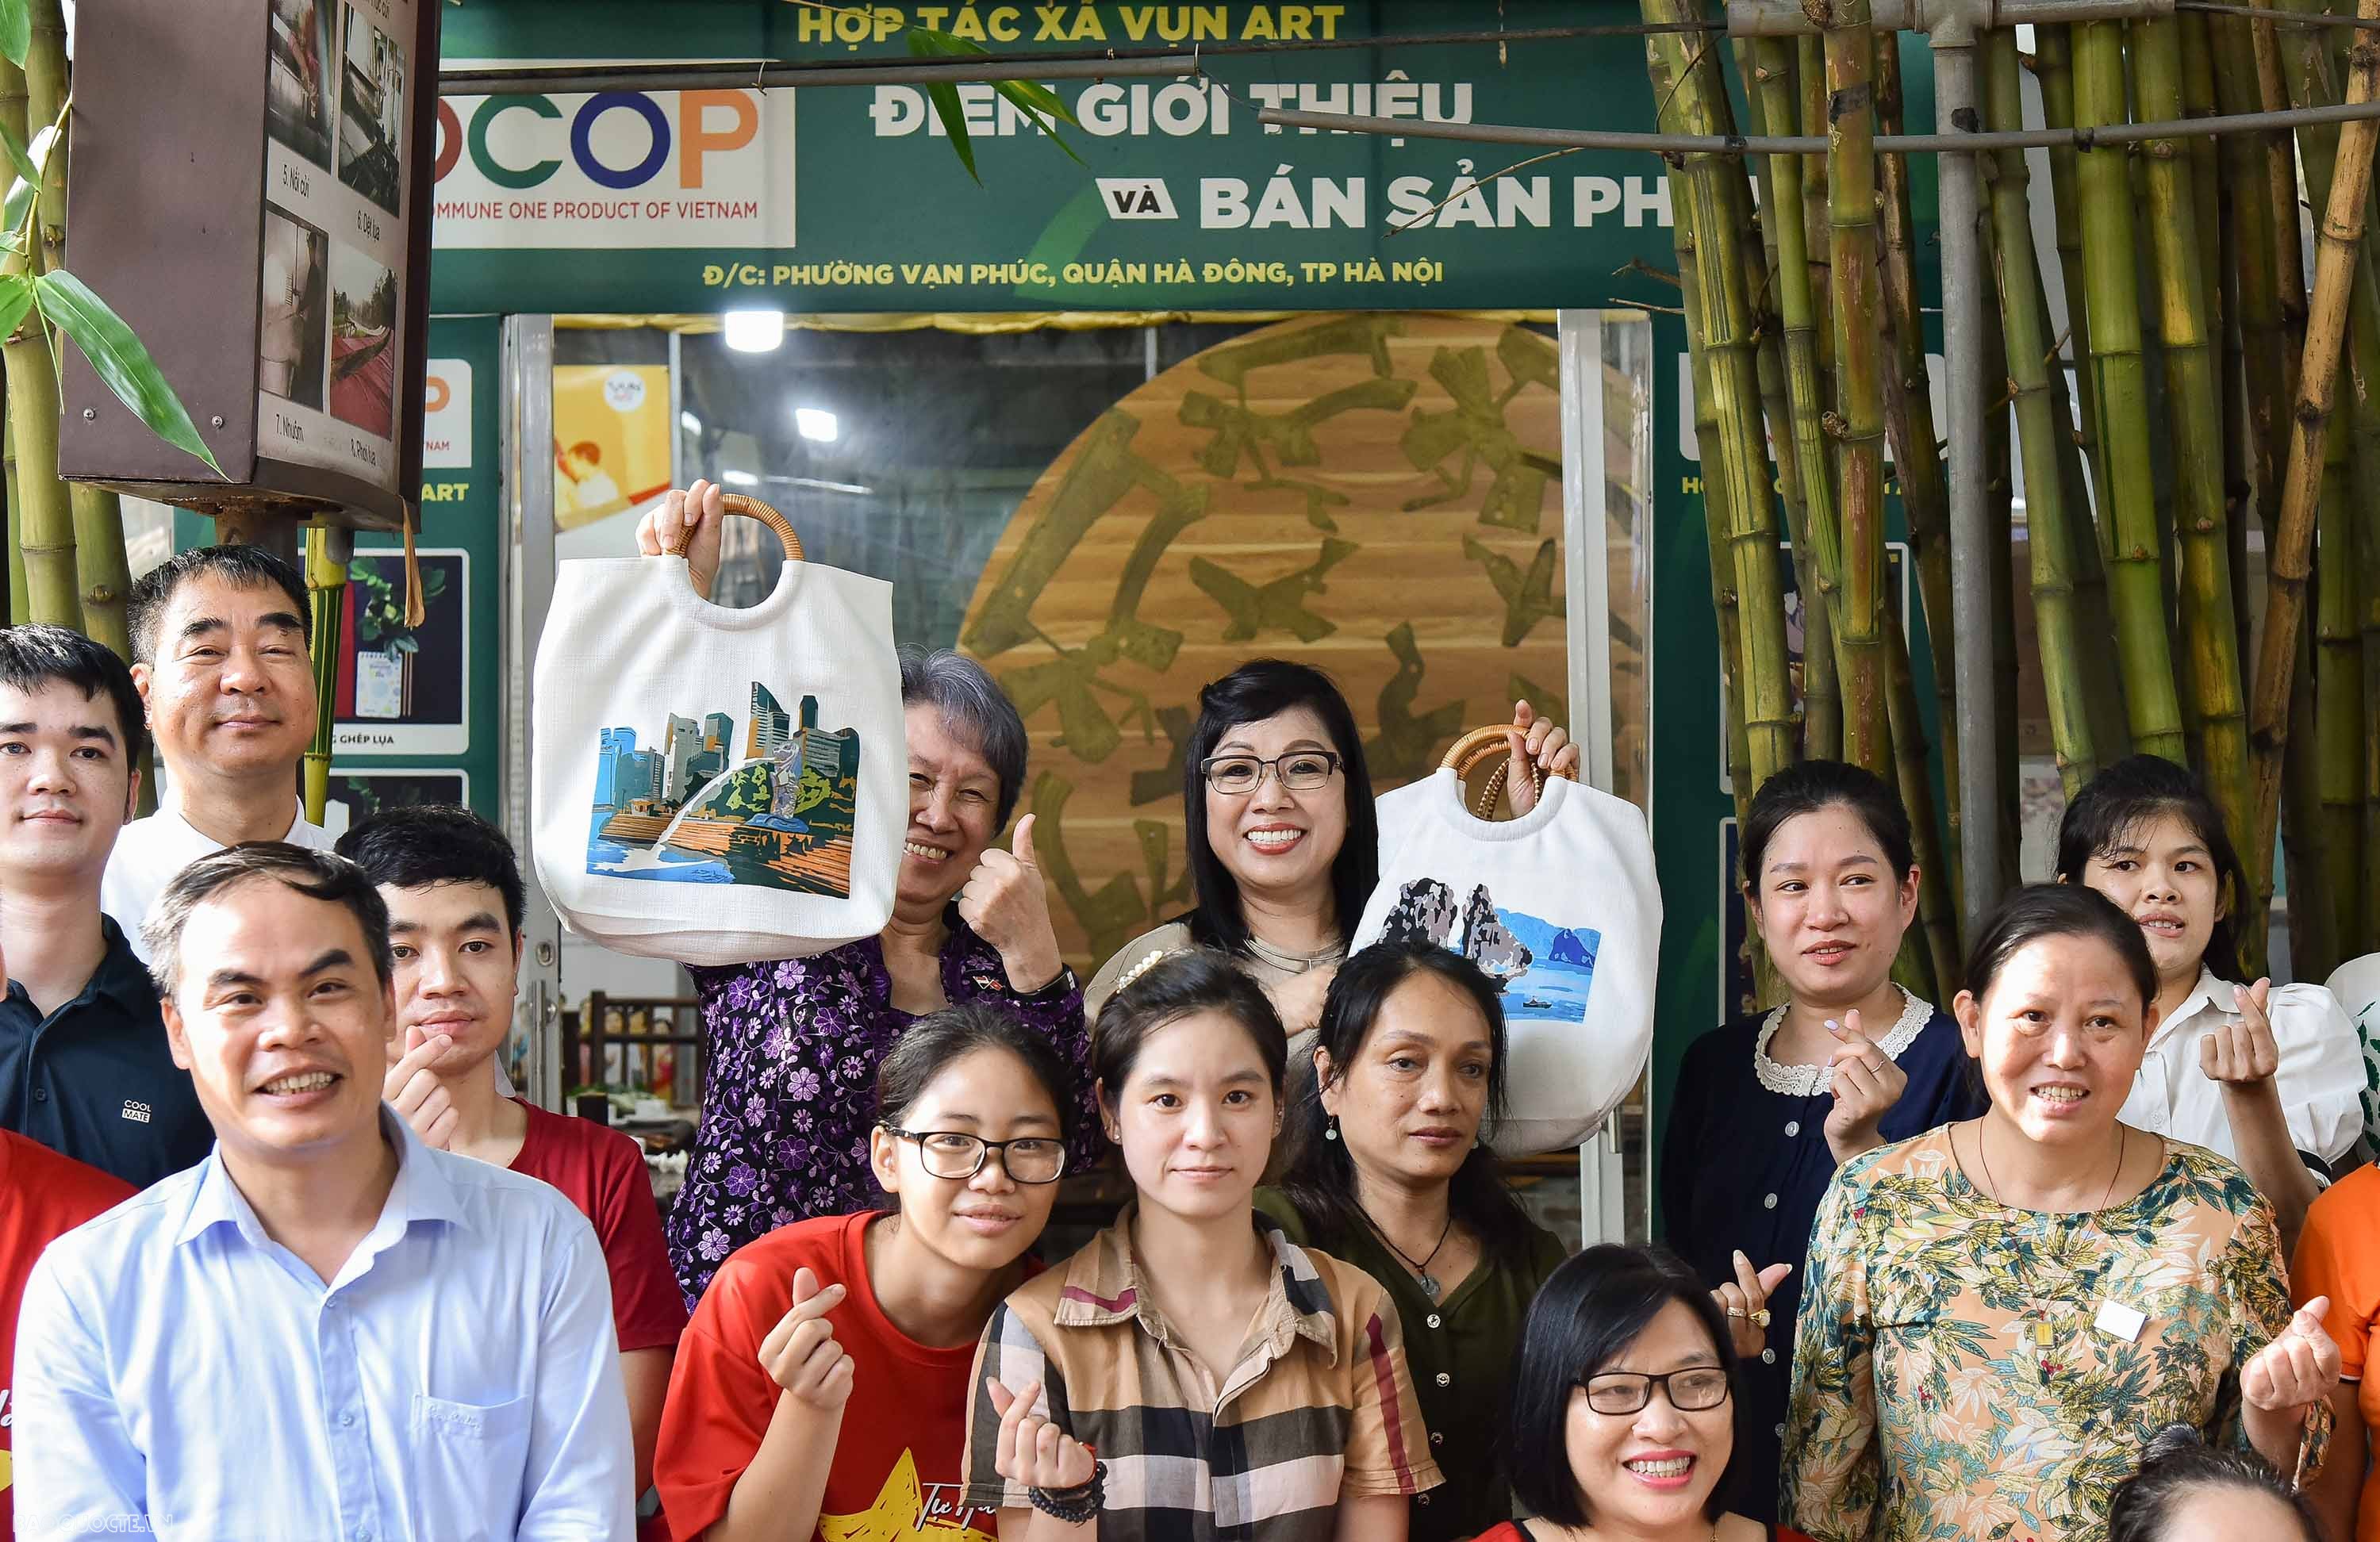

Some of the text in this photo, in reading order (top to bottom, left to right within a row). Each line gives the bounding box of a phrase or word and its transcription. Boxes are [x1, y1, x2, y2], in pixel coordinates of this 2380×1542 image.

[798, 0, 1345, 51] HỢP TÁC XÃ VỤN ART
[1077, 76, 1230, 136] GIỚI
[1250, 70, 1472, 147] THIỆU
[434, 90, 758, 189] COP
[1112, 184, 1161, 213] VÀ
[1200, 163, 1365, 228] BÁN
[1385, 159, 1550, 228] SẢN
[435, 201, 758, 219] MMUNE ONE PRODUCT OF VIETNAM
[703, 257, 1442, 289] Đ/C: PHƯỜNG VẠN PHÚC, QUẬN HÀ ĐÔNG, TP HÀ NỘI
[421, 483, 469, 501] ART
[340, 732, 370, 743] GHÉP
[373, 735, 394, 747] LỤA
[124, 1099, 152, 1112] COOL
[124, 1110, 148, 1122] MATE
